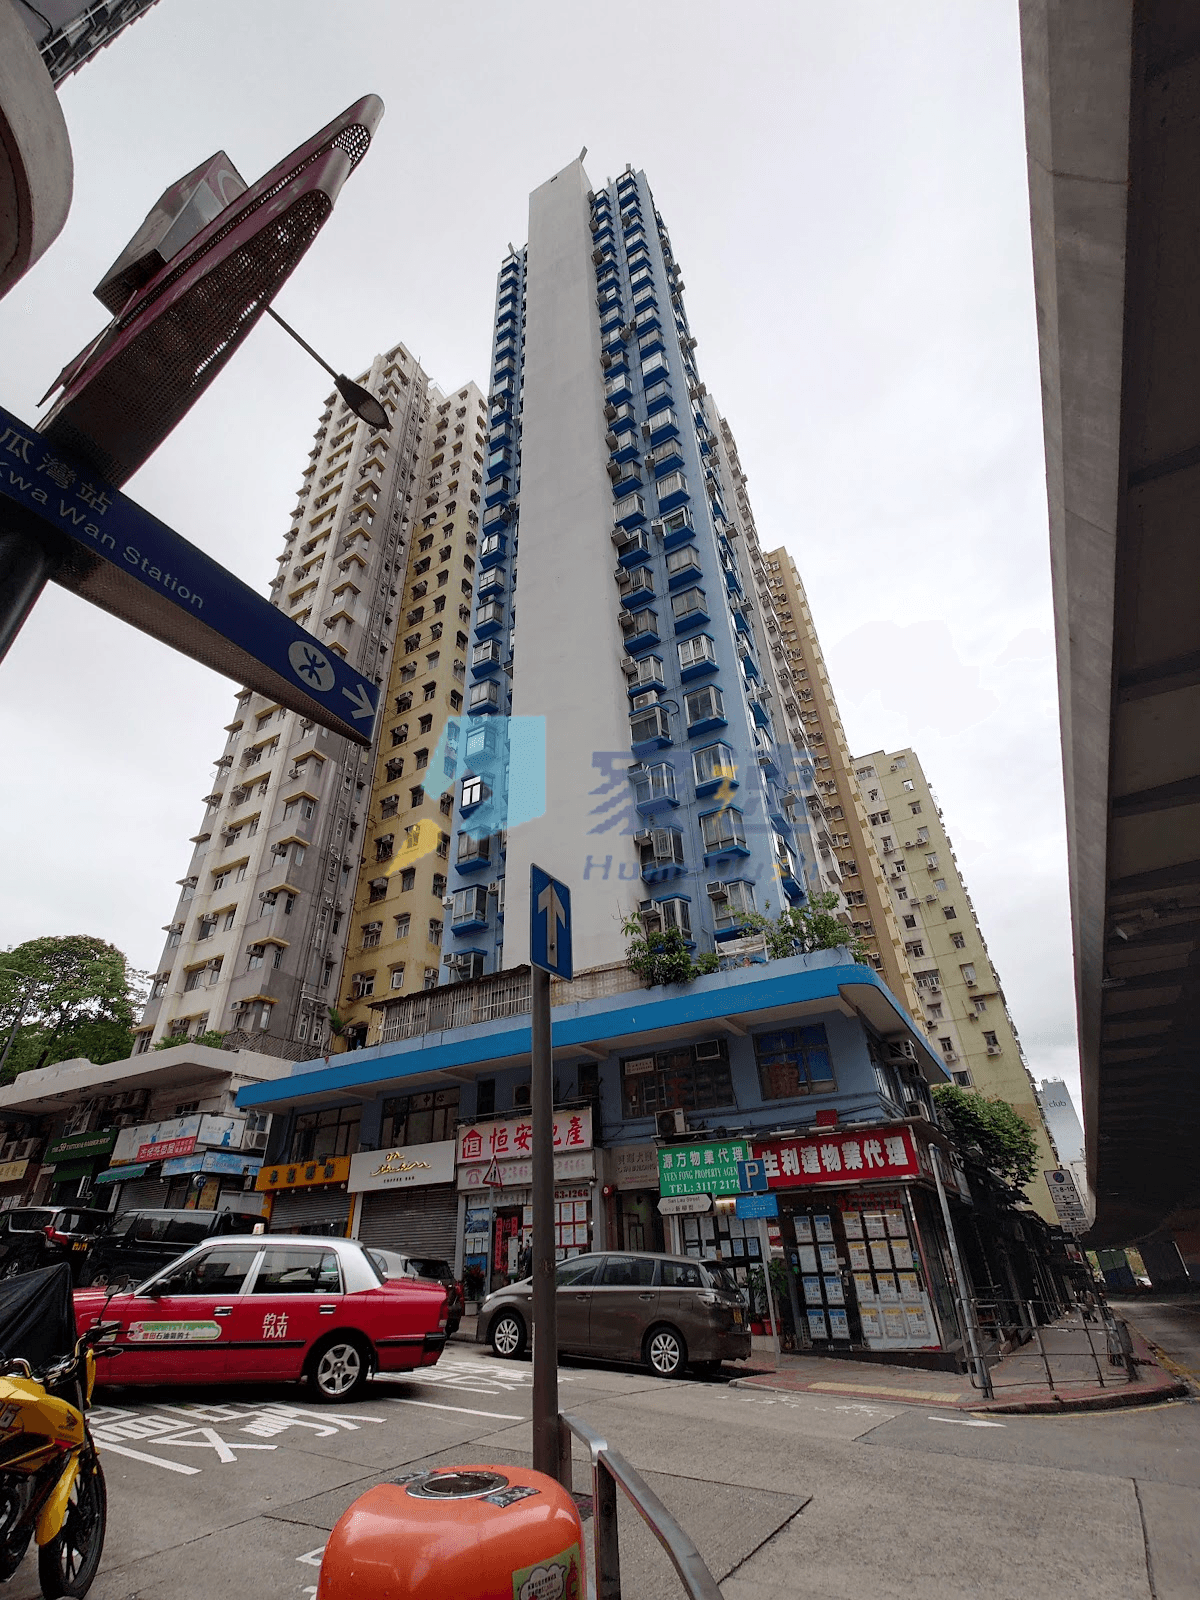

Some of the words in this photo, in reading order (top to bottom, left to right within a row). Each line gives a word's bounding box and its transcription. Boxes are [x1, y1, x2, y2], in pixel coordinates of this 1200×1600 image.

[59, 497, 117, 550] Wan
[124, 546, 205, 610] Station
[1048, 1100, 1067, 1108] club
[463, 1137, 482, 1157] 恒
[663, 1146, 743, 1169] 源方物業代理
[761, 1136, 909, 1178] 生利達物業代理
[694, 1167, 721, 1180] PROPERTY
[722, 1165, 738, 1177] AGEN
[746, 1162, 759, 1189] P
[669, 1183, 694, 1194] TEL:
[696, 1180, 717, 1193] 3117
[263, 1312, 289, 1325] 的士
[262, 1325, 288, 1339] TAXI
